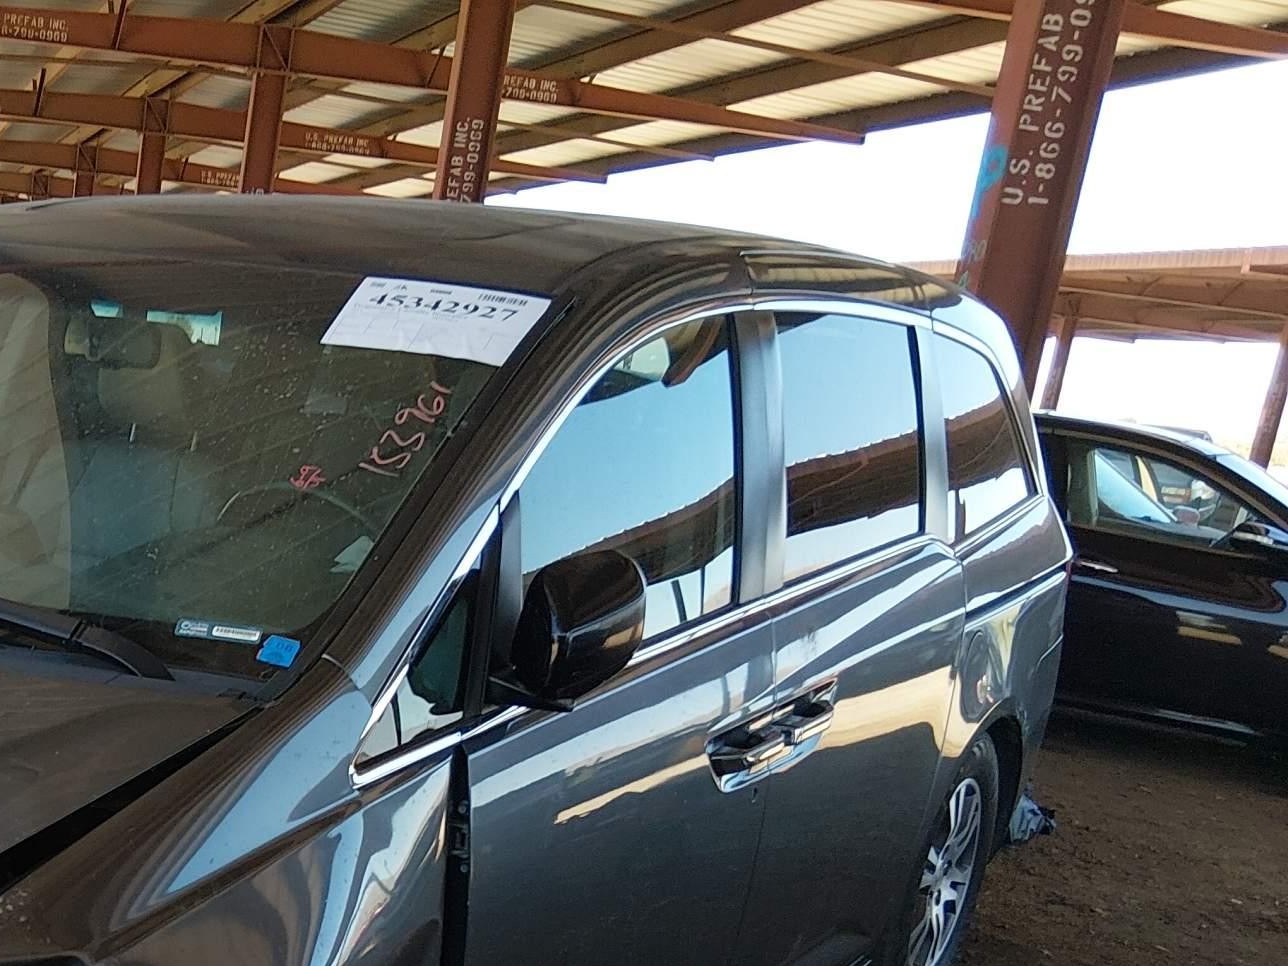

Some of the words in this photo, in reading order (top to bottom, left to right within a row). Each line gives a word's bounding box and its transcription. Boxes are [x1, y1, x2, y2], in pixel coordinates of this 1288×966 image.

[1018, 12, 1064, 132] PREFAB
[453, 117, 471, 148] INC.
[369, 292, 519, 321] 45342927
